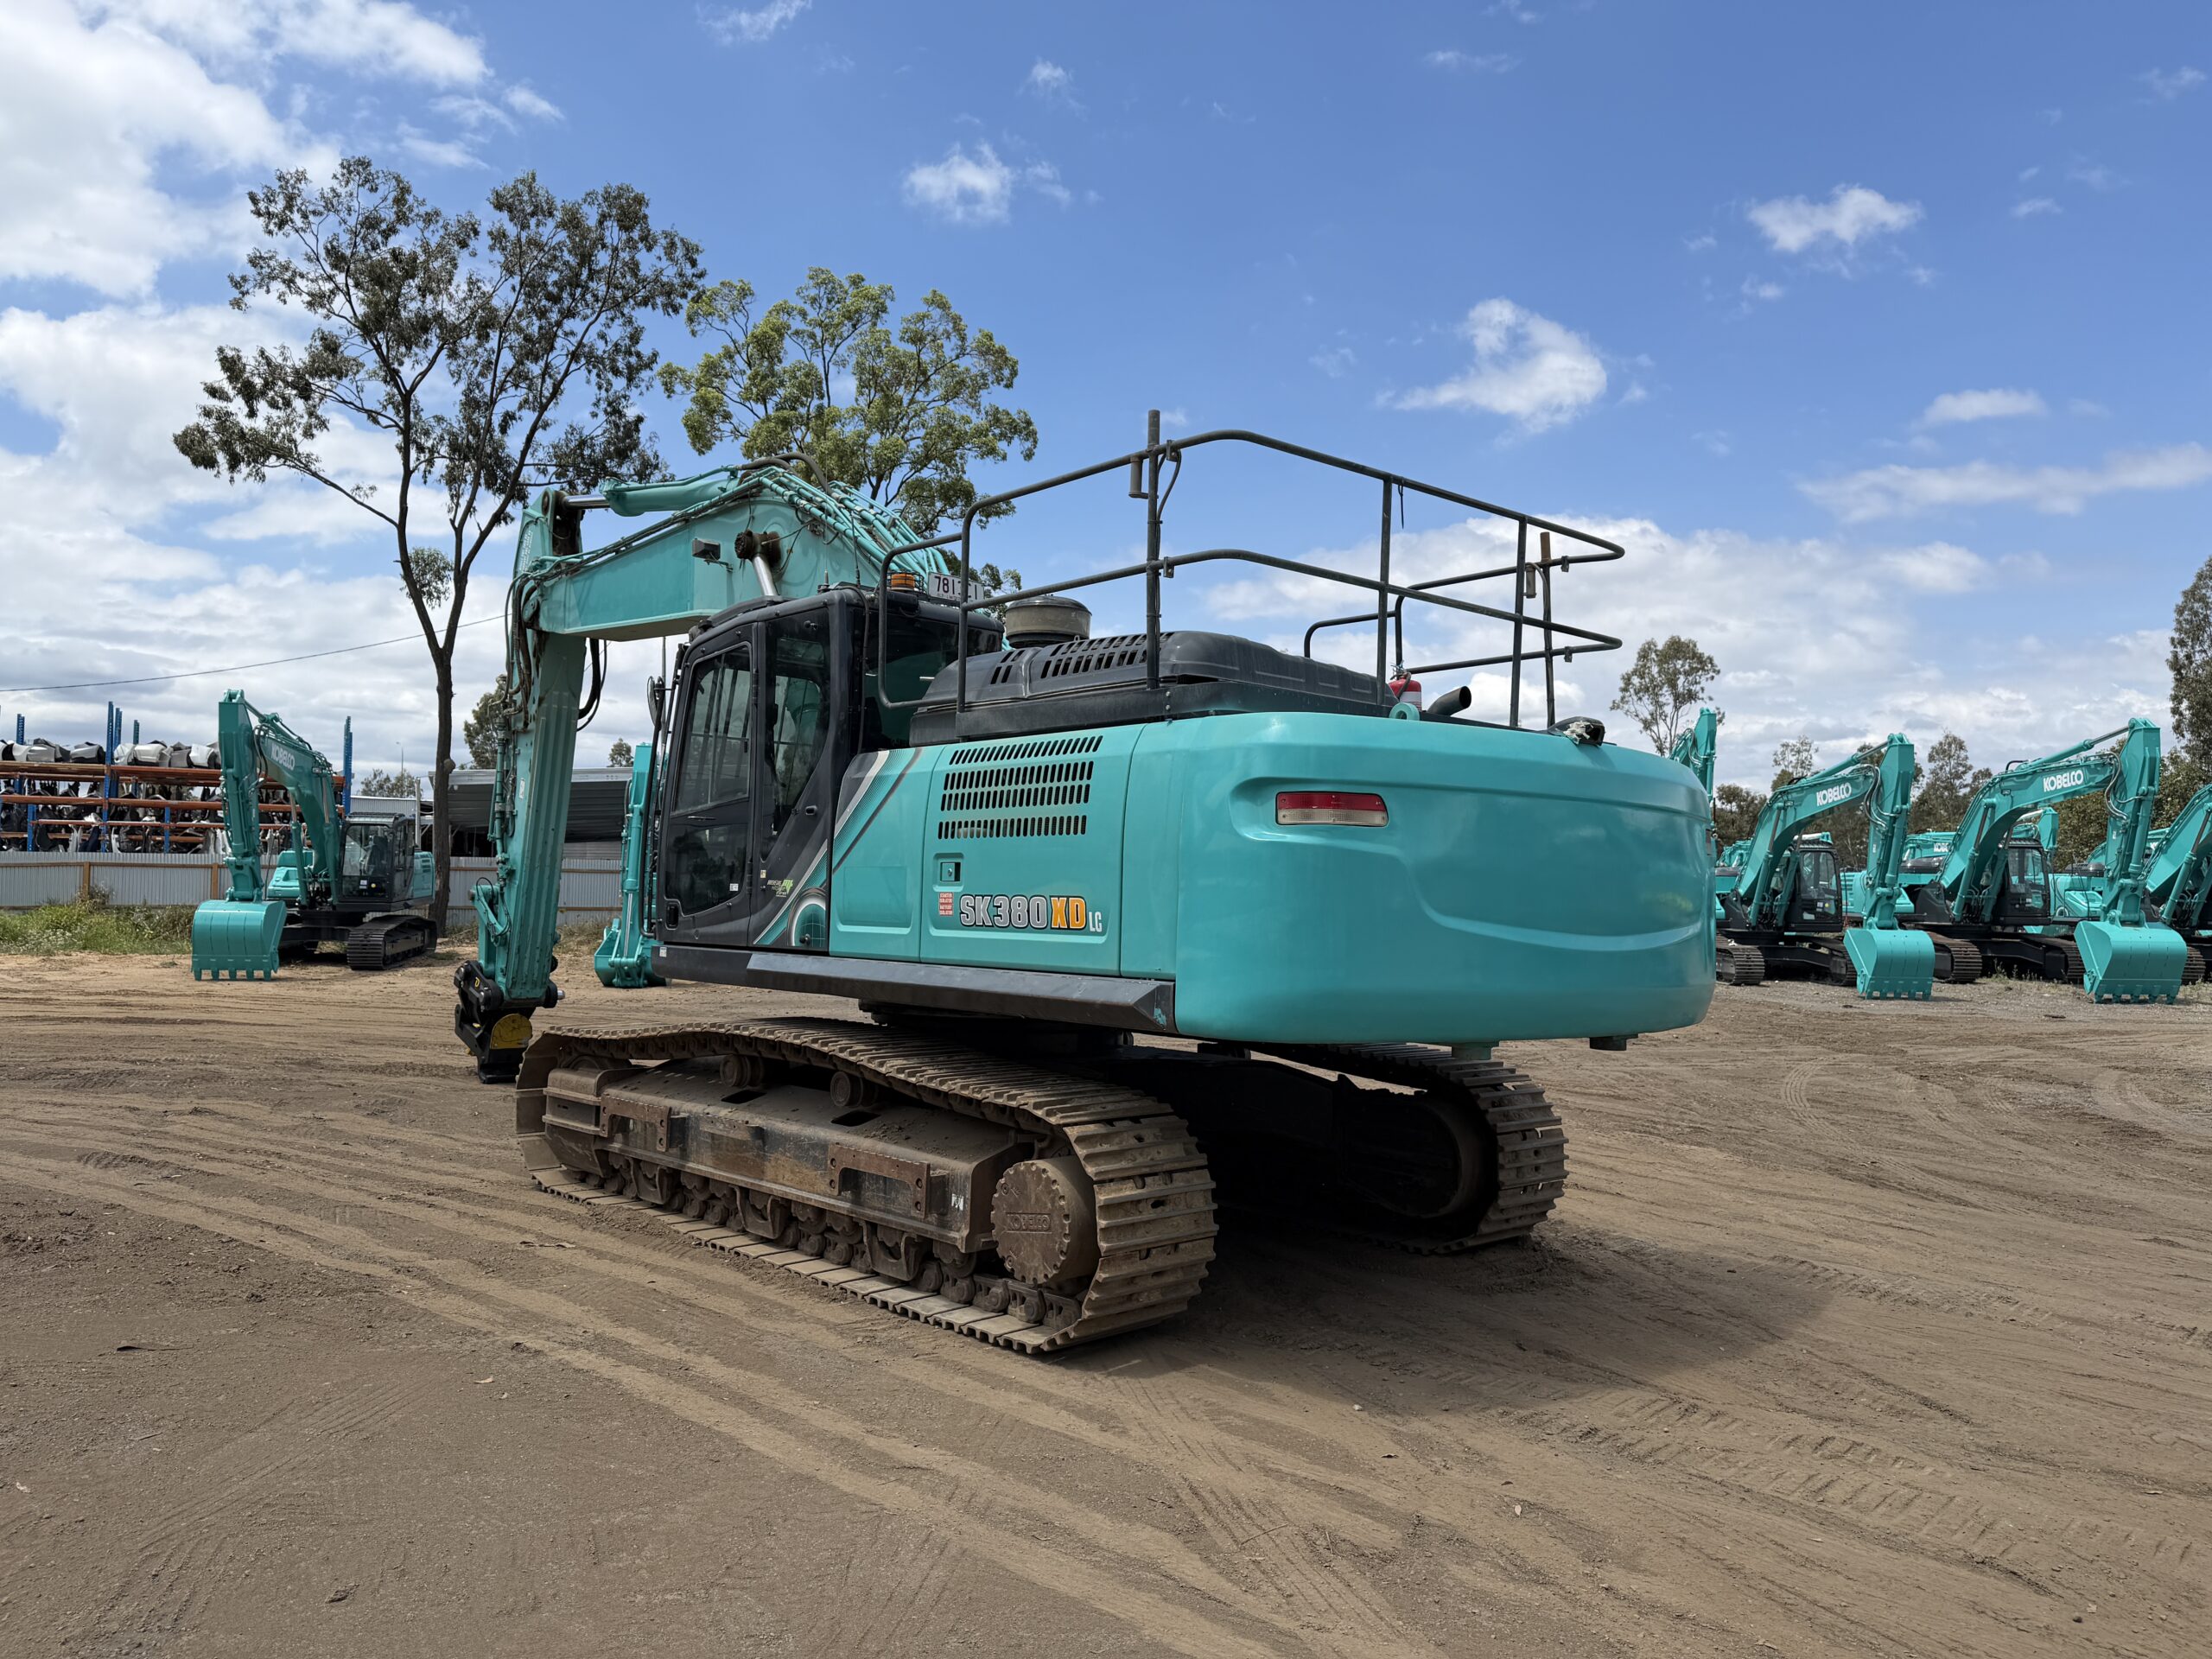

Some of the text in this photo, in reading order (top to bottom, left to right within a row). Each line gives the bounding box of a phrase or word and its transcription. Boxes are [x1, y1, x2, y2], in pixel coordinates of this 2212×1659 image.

[270, 743, 295, 771] KOBELCO
[2043, 770, 2084, 792] KOBELCO
[1816, 782, 1852, 806] KOBELCO
[1089, 912, 1102, 932] LC
